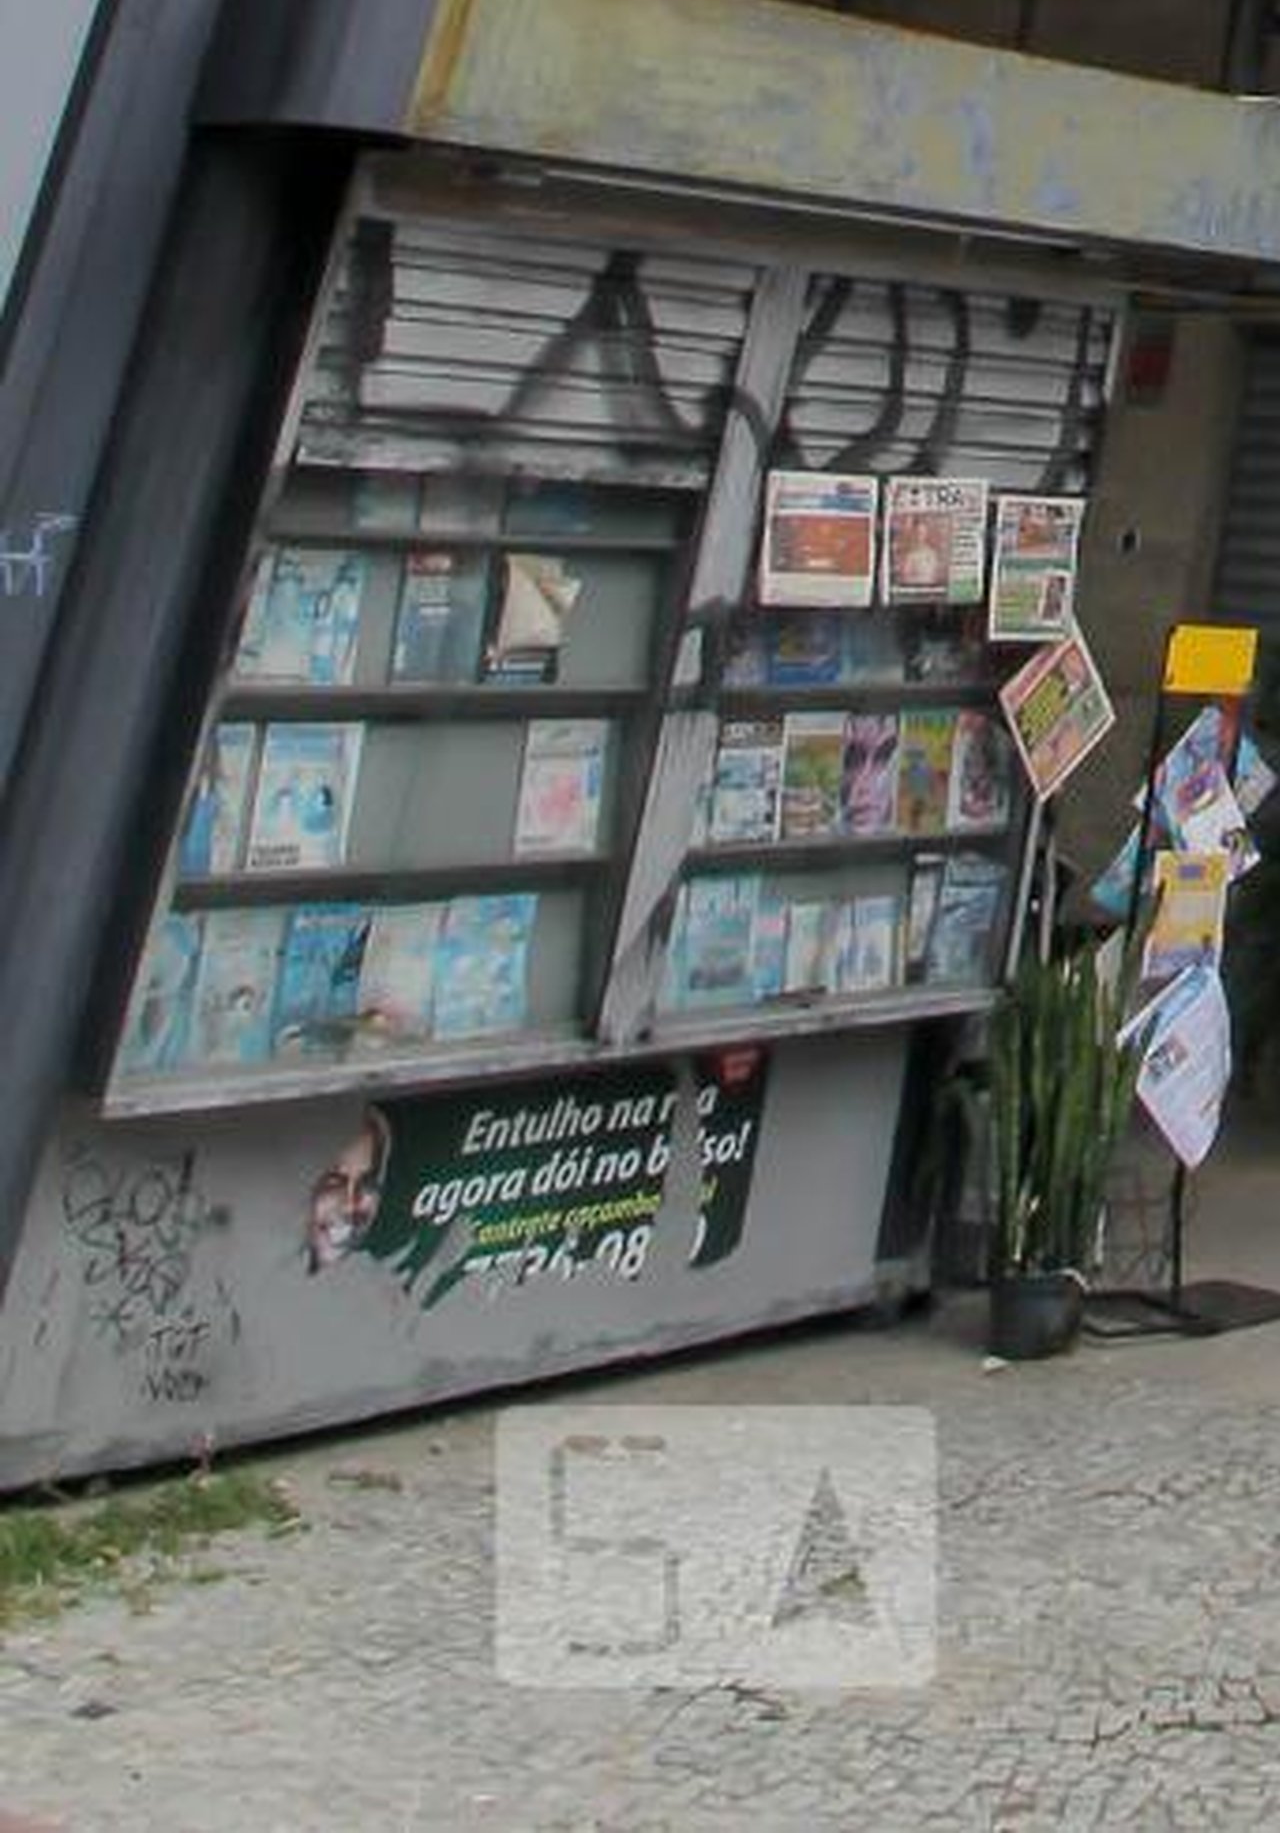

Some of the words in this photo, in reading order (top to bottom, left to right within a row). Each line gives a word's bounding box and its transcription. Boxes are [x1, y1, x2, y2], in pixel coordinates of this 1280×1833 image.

[462, 1096, 602, 1155] Entulho
[606, 1103, 656, 1135] na
[658, 1083, 718, 1123] ra
[411, 1168, 526, 1225] agora
[530, 1143, 592, 1195] dói
[594, 1147, 640, 1185] no
[646, 1121, 752, 1179] bso!
